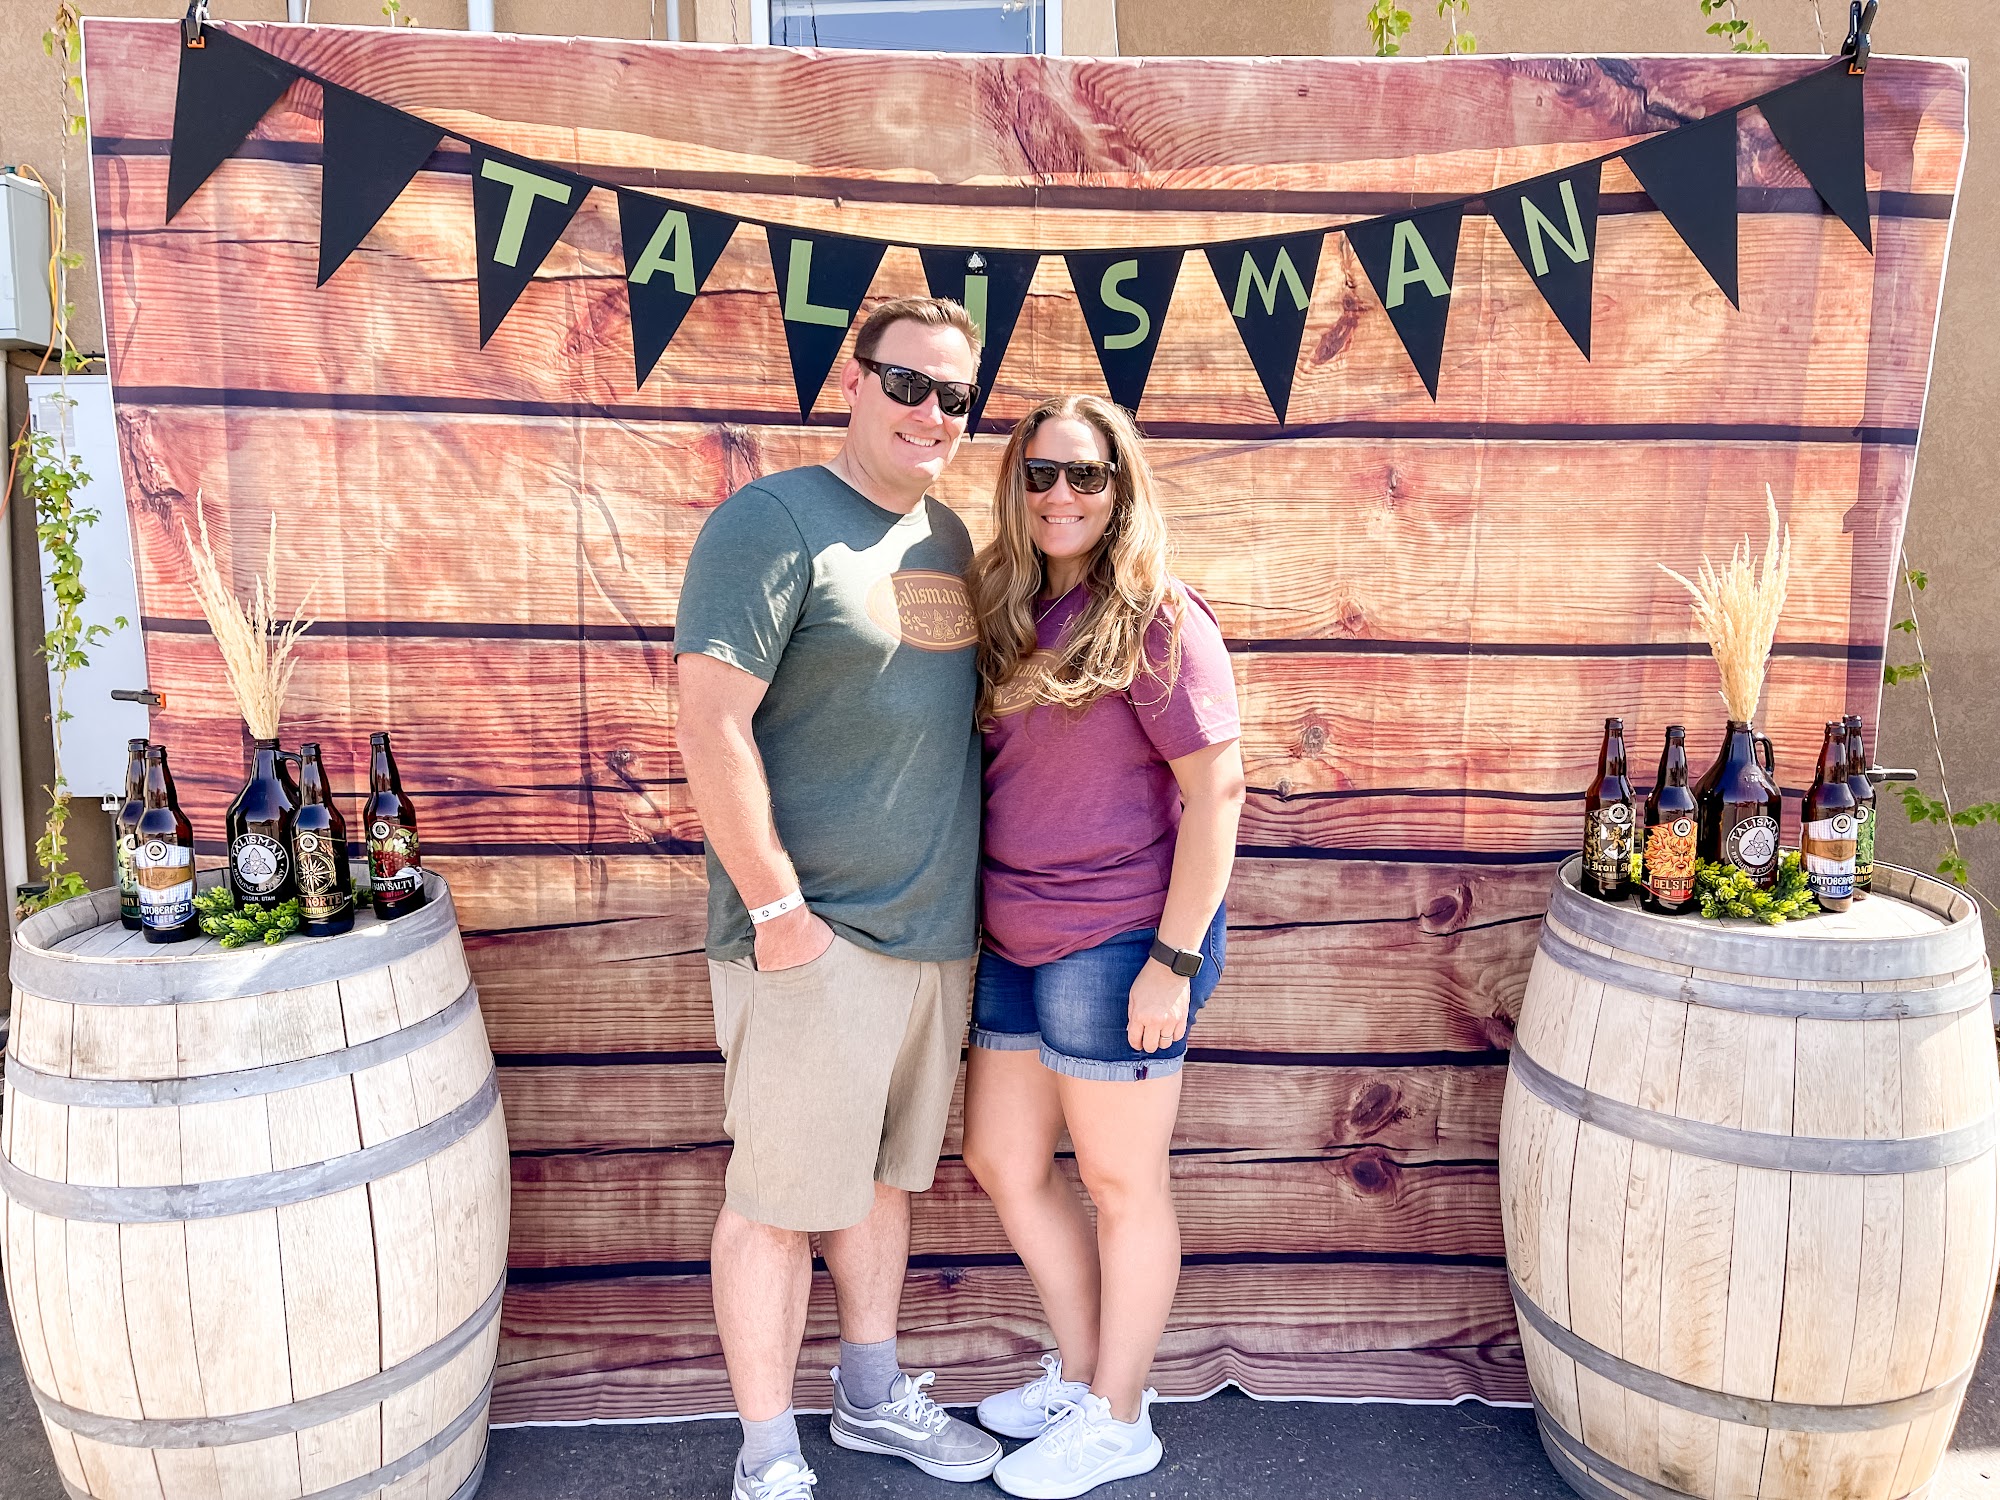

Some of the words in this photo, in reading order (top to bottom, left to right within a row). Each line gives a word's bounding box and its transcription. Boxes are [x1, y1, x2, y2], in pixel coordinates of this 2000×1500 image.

[889, 581, 974, 609] alismani
[1730, 818, 1779, 842] TALISMAN
[231, 835, 286, 862] TALISMAN
[1591, 861, 1617, 873] Iron
[387, 879, 412, 890] SALTY
[1653, 879, 1680, 890] BEL'S
[305, 893, 342, 907] NORTE
[141, 902, 190, 915] TOBERFEST
